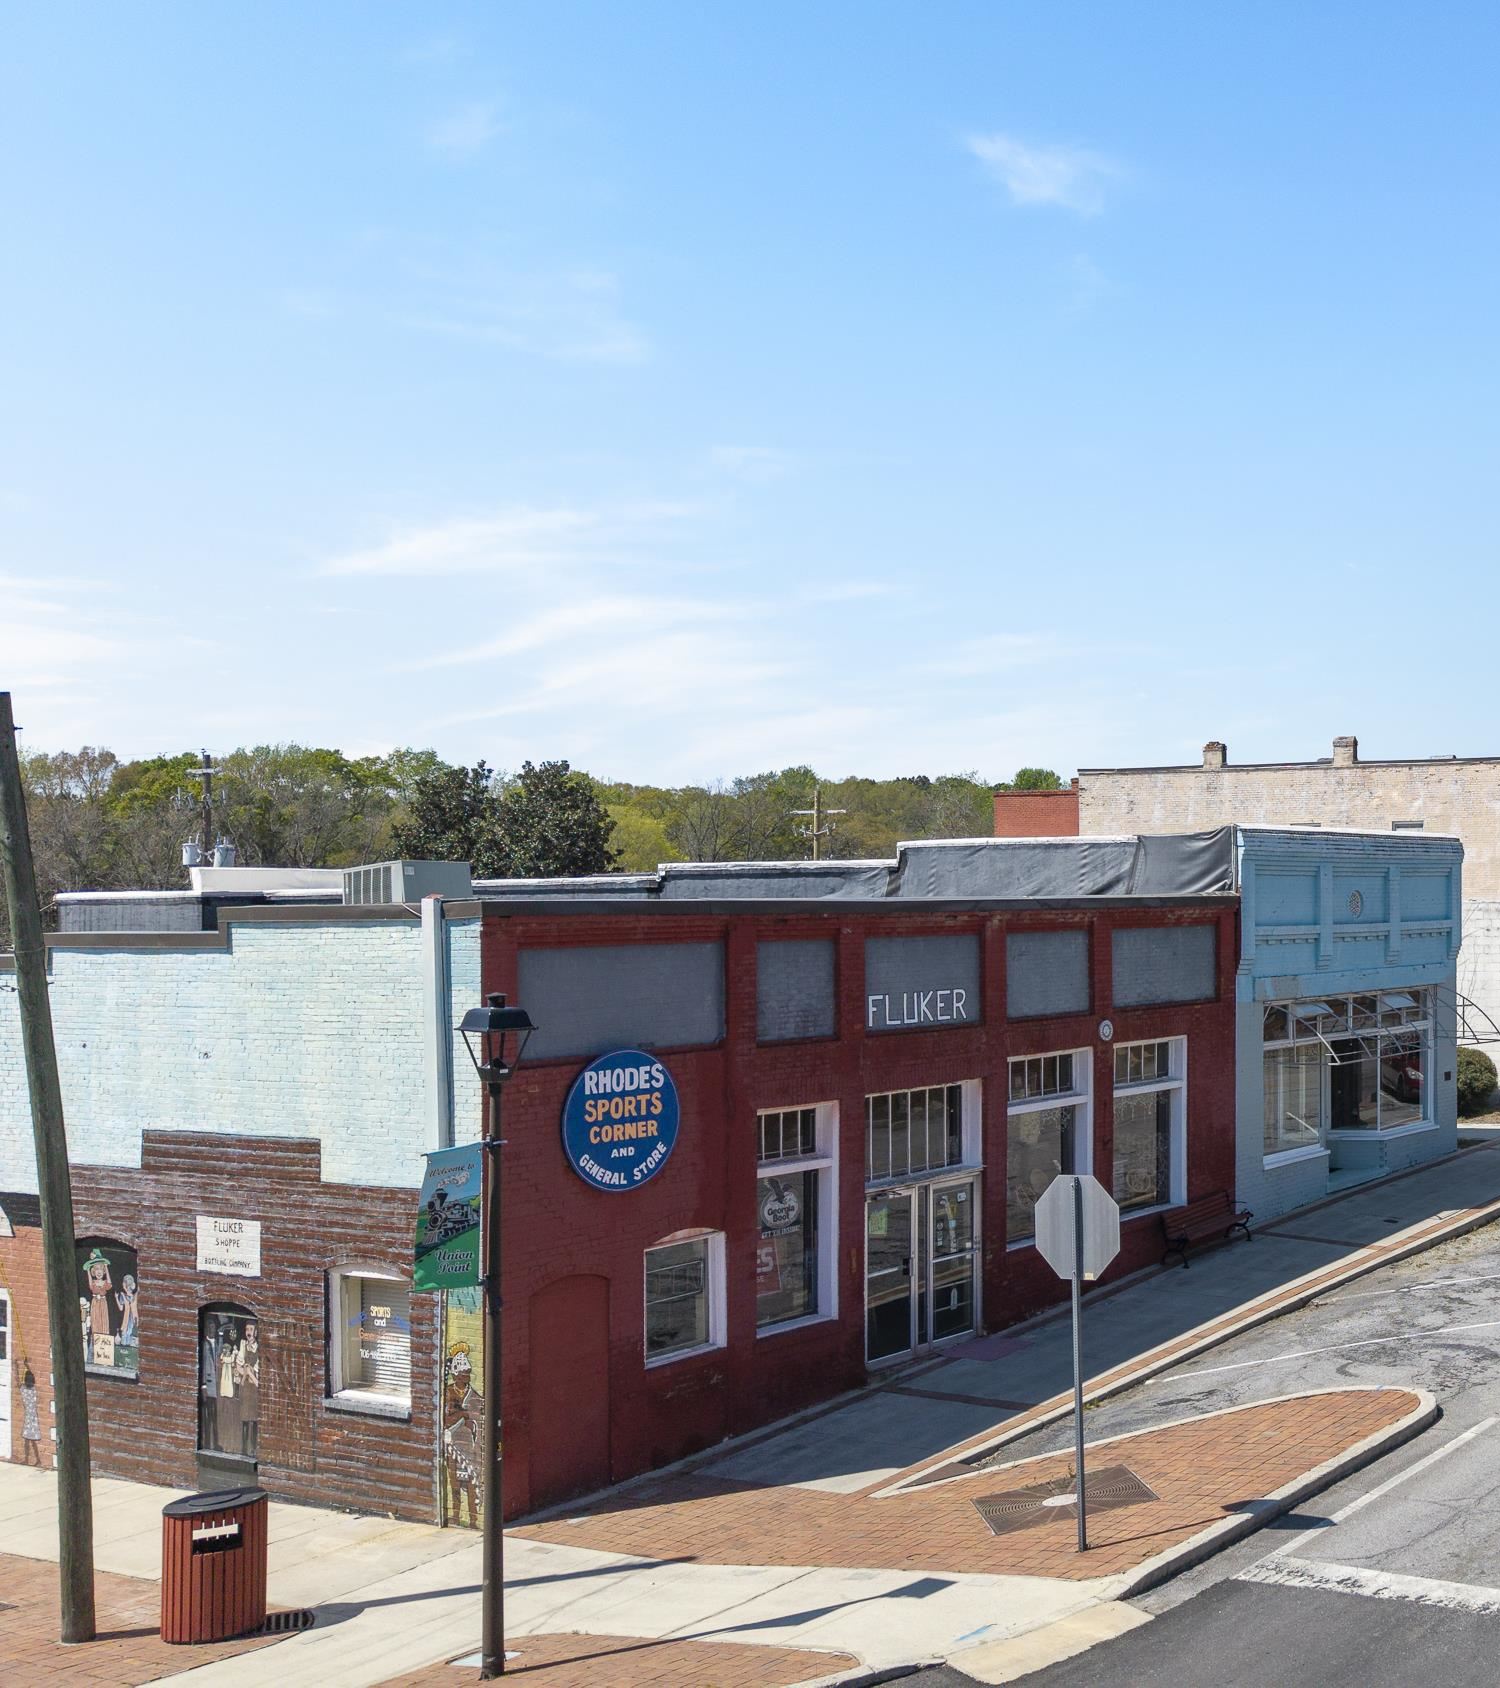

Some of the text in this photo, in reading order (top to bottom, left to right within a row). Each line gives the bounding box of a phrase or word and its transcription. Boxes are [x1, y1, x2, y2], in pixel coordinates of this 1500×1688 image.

[868, 989, 967, 1027] FLUKER
[584, 1063, 665, 1095] RHODES
[584, 1091, 663, 1123] SPORTS
[589, 1120, 658, 1144] CORNER
[611, 1146, 635, 1158] AND
[579, 1141, 667, 1185] GENERAL STORE
[428, 1165, 466, 1178] Welcome
[213, 1220, 244, 1233] FLUKER
[215, 1238, 241, 1248] SHOPPE
[435, 1250, 474, 1261] Union
[438, 1261, 471, 1274] Point
[370, 1305, 391, 1319] SPORTS
[374, 1318, 387, 1327] and
